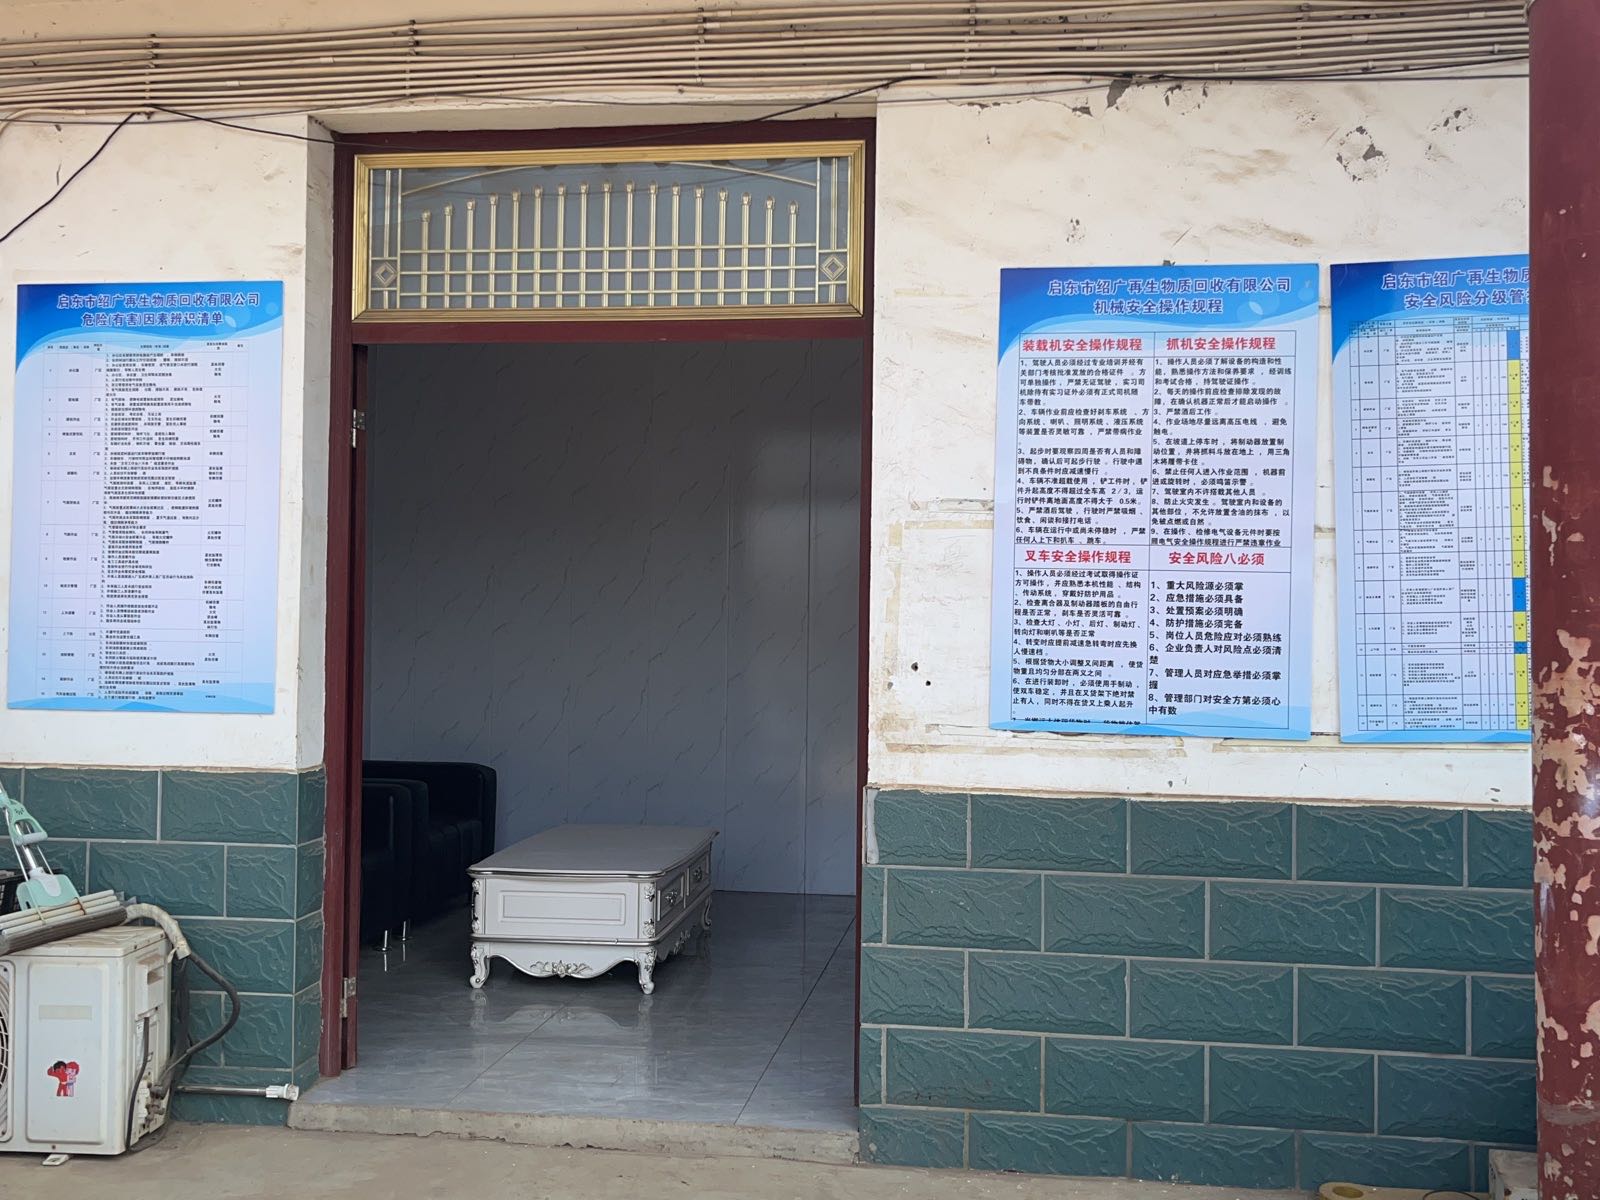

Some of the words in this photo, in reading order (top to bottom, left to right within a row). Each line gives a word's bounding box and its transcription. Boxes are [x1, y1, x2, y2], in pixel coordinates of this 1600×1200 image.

[1048, 278, 1291, 296] 启东市绍广再生物质回收有限公司
[57, 293, 260, 309] 启东市绍广再生物质回收有限公司
[1094, 298, 1223, 314] 机械安全操作规程
[1404, 289, 1529, 310] 安全风险分级管
[81, 312, 224, 326] 危险(有害)因素辨识清单
[1023, 338, 1142, 352] 装载机安全操作规程
[1166, 337, 1276, 350] 抓机安全操作规程
[1025, 550, 1132, 563] 叉车安全操作规程
[1168, 552, 1264, 565] 安全风险八必须
